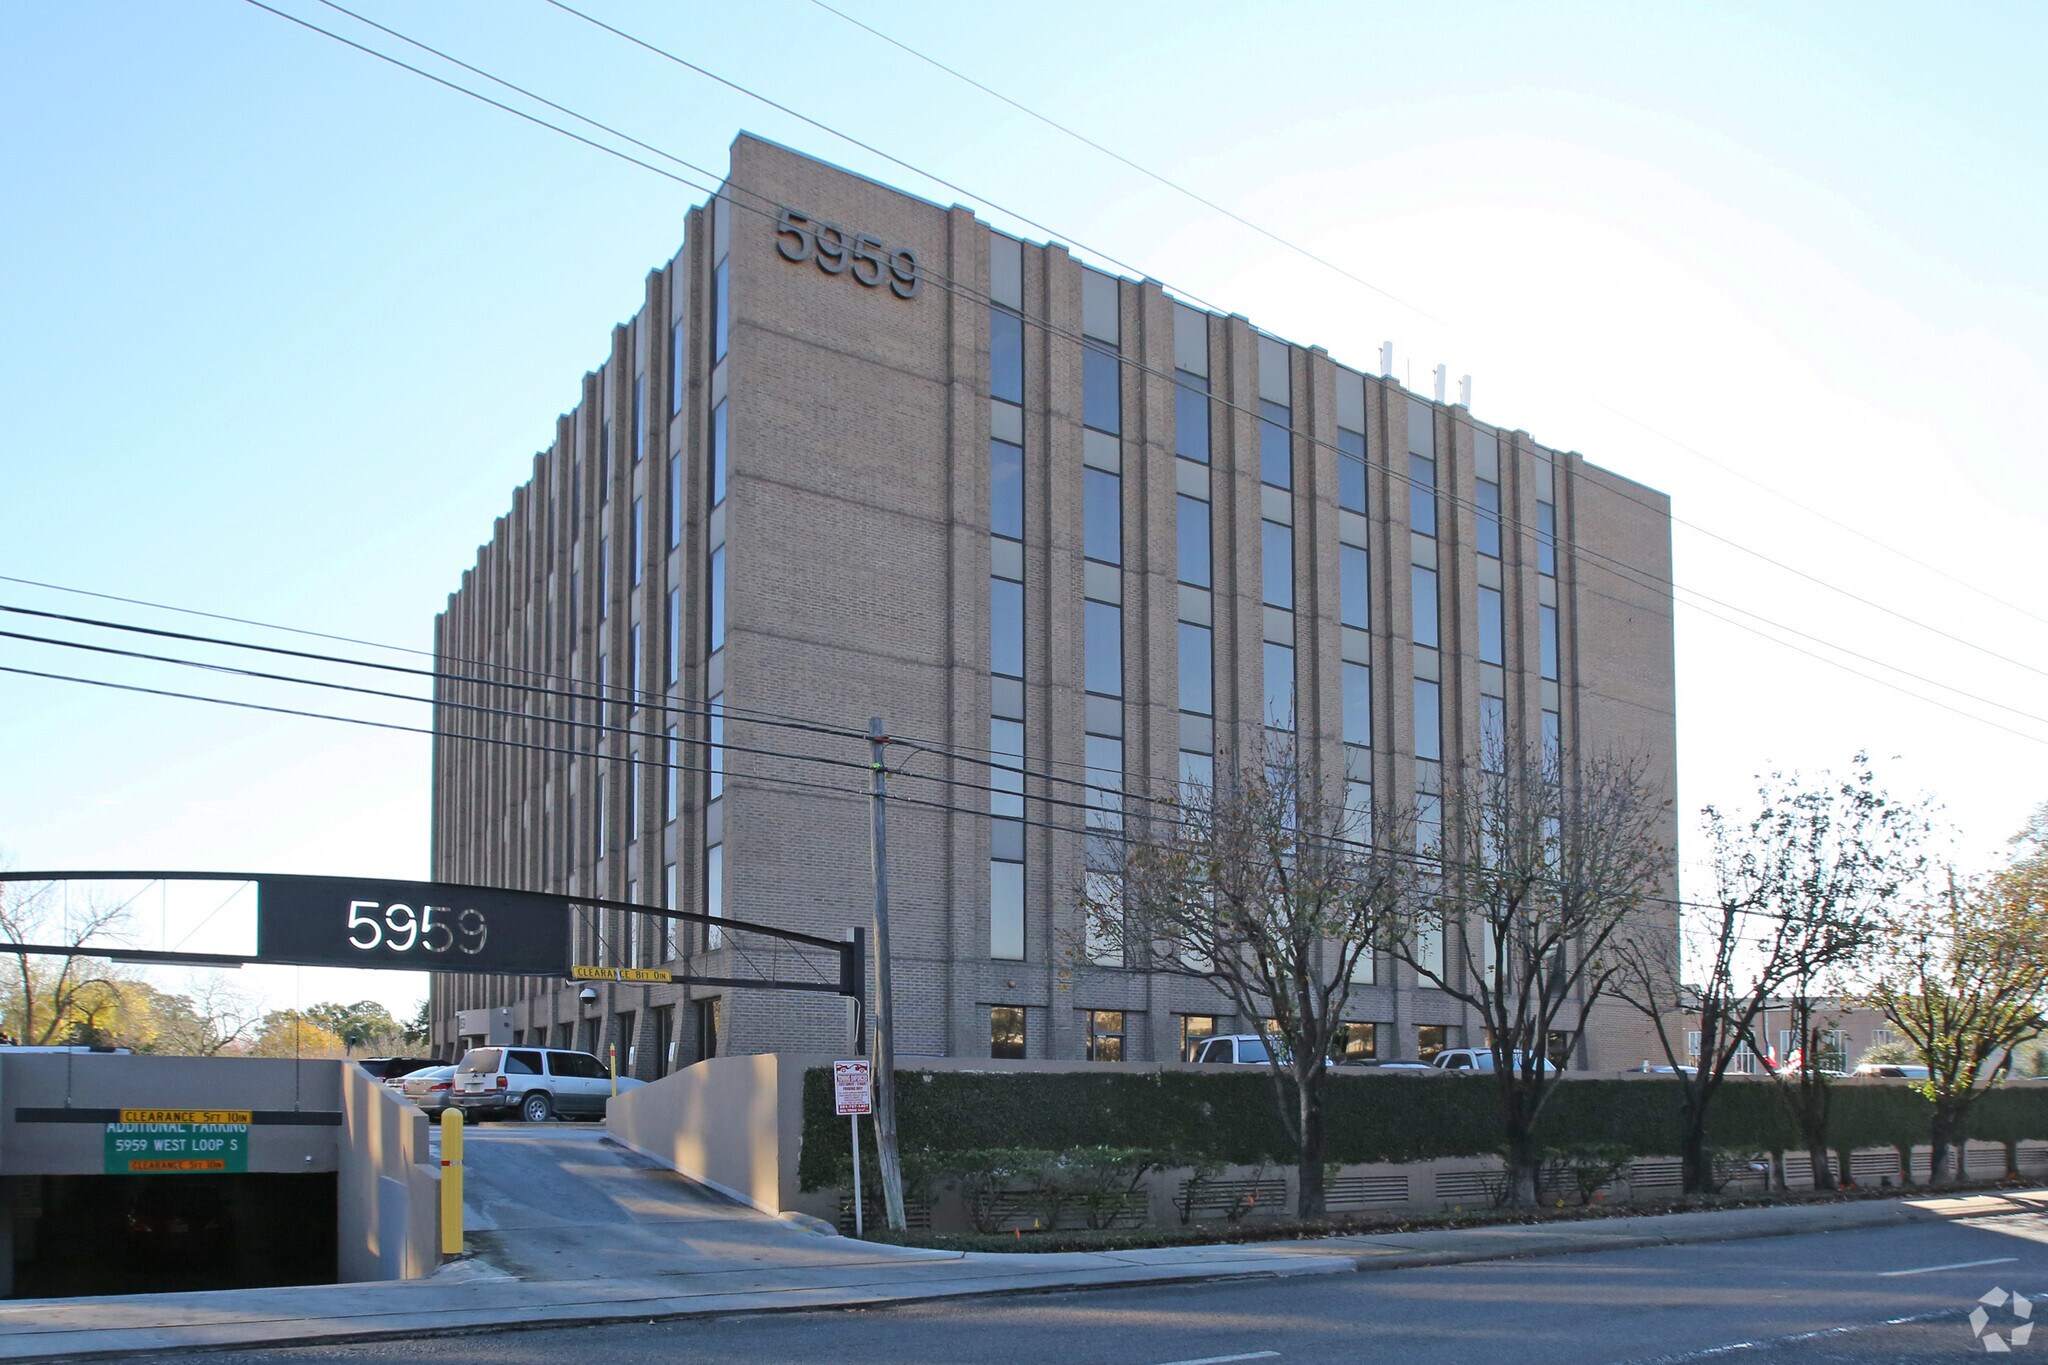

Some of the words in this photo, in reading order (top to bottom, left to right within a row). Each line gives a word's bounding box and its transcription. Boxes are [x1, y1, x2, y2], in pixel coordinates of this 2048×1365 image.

[776, 206, 922, 299] 5959
[348, 900, 488, 955] 5959
[578, 968, 630, 978] CLEARANCE
[125, 1111, 195, 1122] CLEARANCE
[203, 1112, 220, 1122] 5FT
[227, 1113, 247, 1122] 10IN
[107, 1123, 186, 1133] ADDITIONAL
[192, 1124, 247, 1133] PARKING
[116, 1140, 147, 1151] 5959
[154, 1140, 187, 1151] WEST
[192, 1140, 224, 1151] LOOP
[230, 1140, 238, 1151] S
